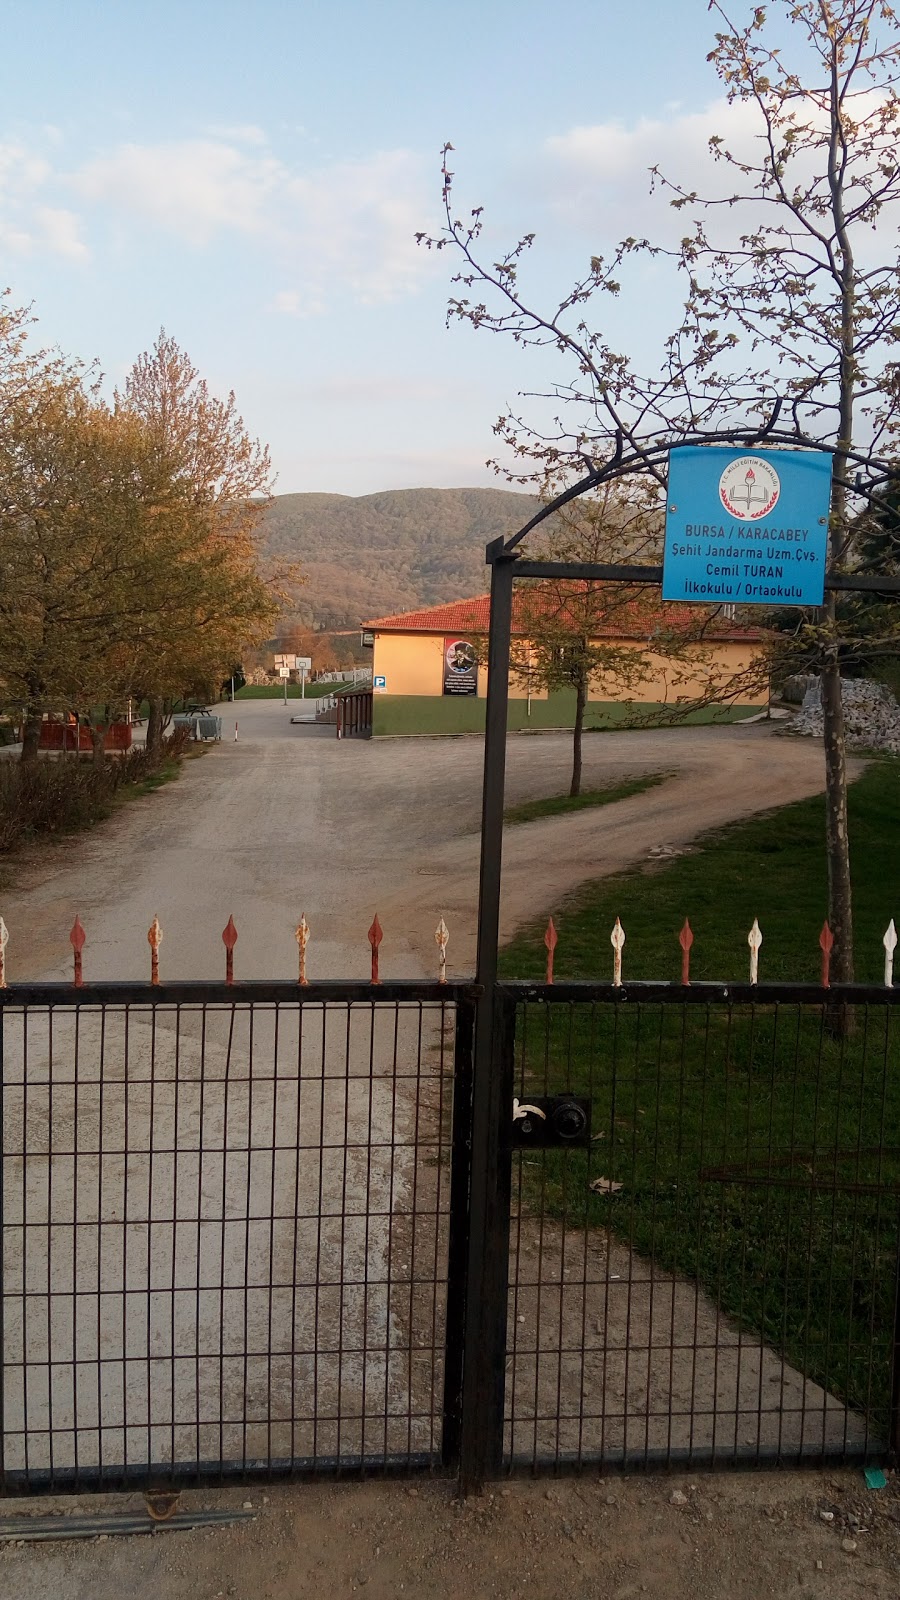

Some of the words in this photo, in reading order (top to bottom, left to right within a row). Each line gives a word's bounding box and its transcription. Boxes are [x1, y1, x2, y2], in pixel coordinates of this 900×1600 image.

[685, 525, 725, 538] BURSA
[728, 525, 735, 539] /
[738, 526, 809, 541] KARACABEY
[672, 543, 702, 556] Şehit
[705, 545, 762, 558] Jandarma
[767, 548, 819, 563] Uzm.Çvş.
[706, 564, 739, 576] Cemil
[743, 565, 783, 577] TURAN
[684, 578, 732, 594] İlkokulu
[736, 582, 742, 595] /
[745, 584, 802, 597] Ortaokulu
